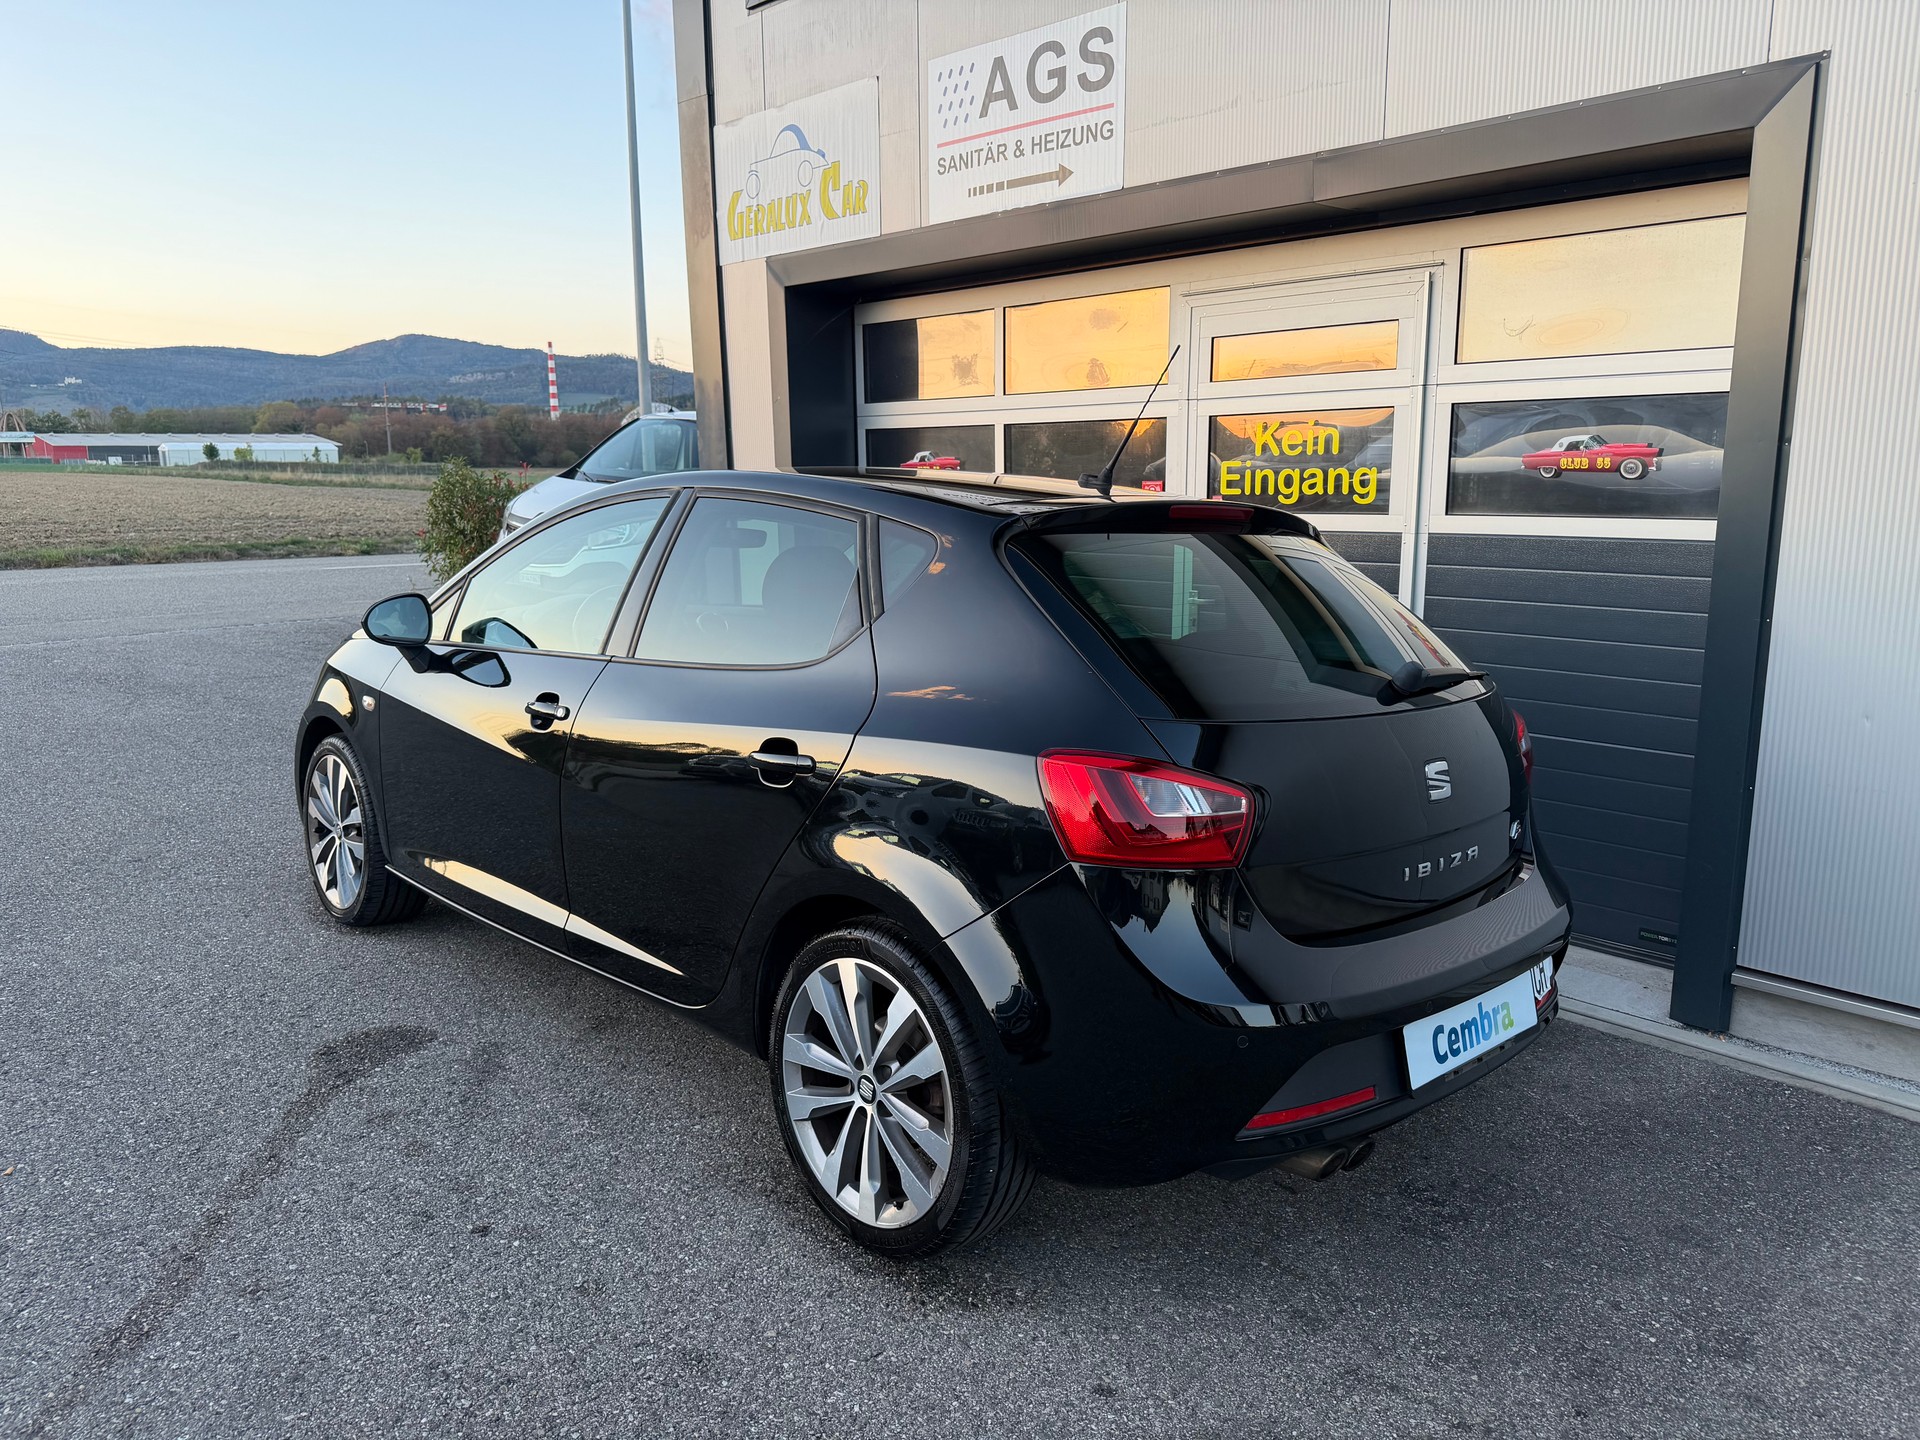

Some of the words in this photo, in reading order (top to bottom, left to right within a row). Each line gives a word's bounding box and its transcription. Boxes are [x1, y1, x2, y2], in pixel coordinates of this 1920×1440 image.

[978, 26, 1115, 119] AGS
[937, 142, 1008, 176] SANITÄR
[1013, 139, 1025, 158] &
[1031, 119, 1114, 155] HEIZUNG
[1255, 419, 1340, 457] Kein
[1220, 460, 1378, 505] Eingang
[1559, 457, 1589, 469] CLUB
[1596, 457, 1611, 469] 55
[1403, 845, 1479, 882] IBIZA
[1432, 1002, 1514, 1065] Cembra
